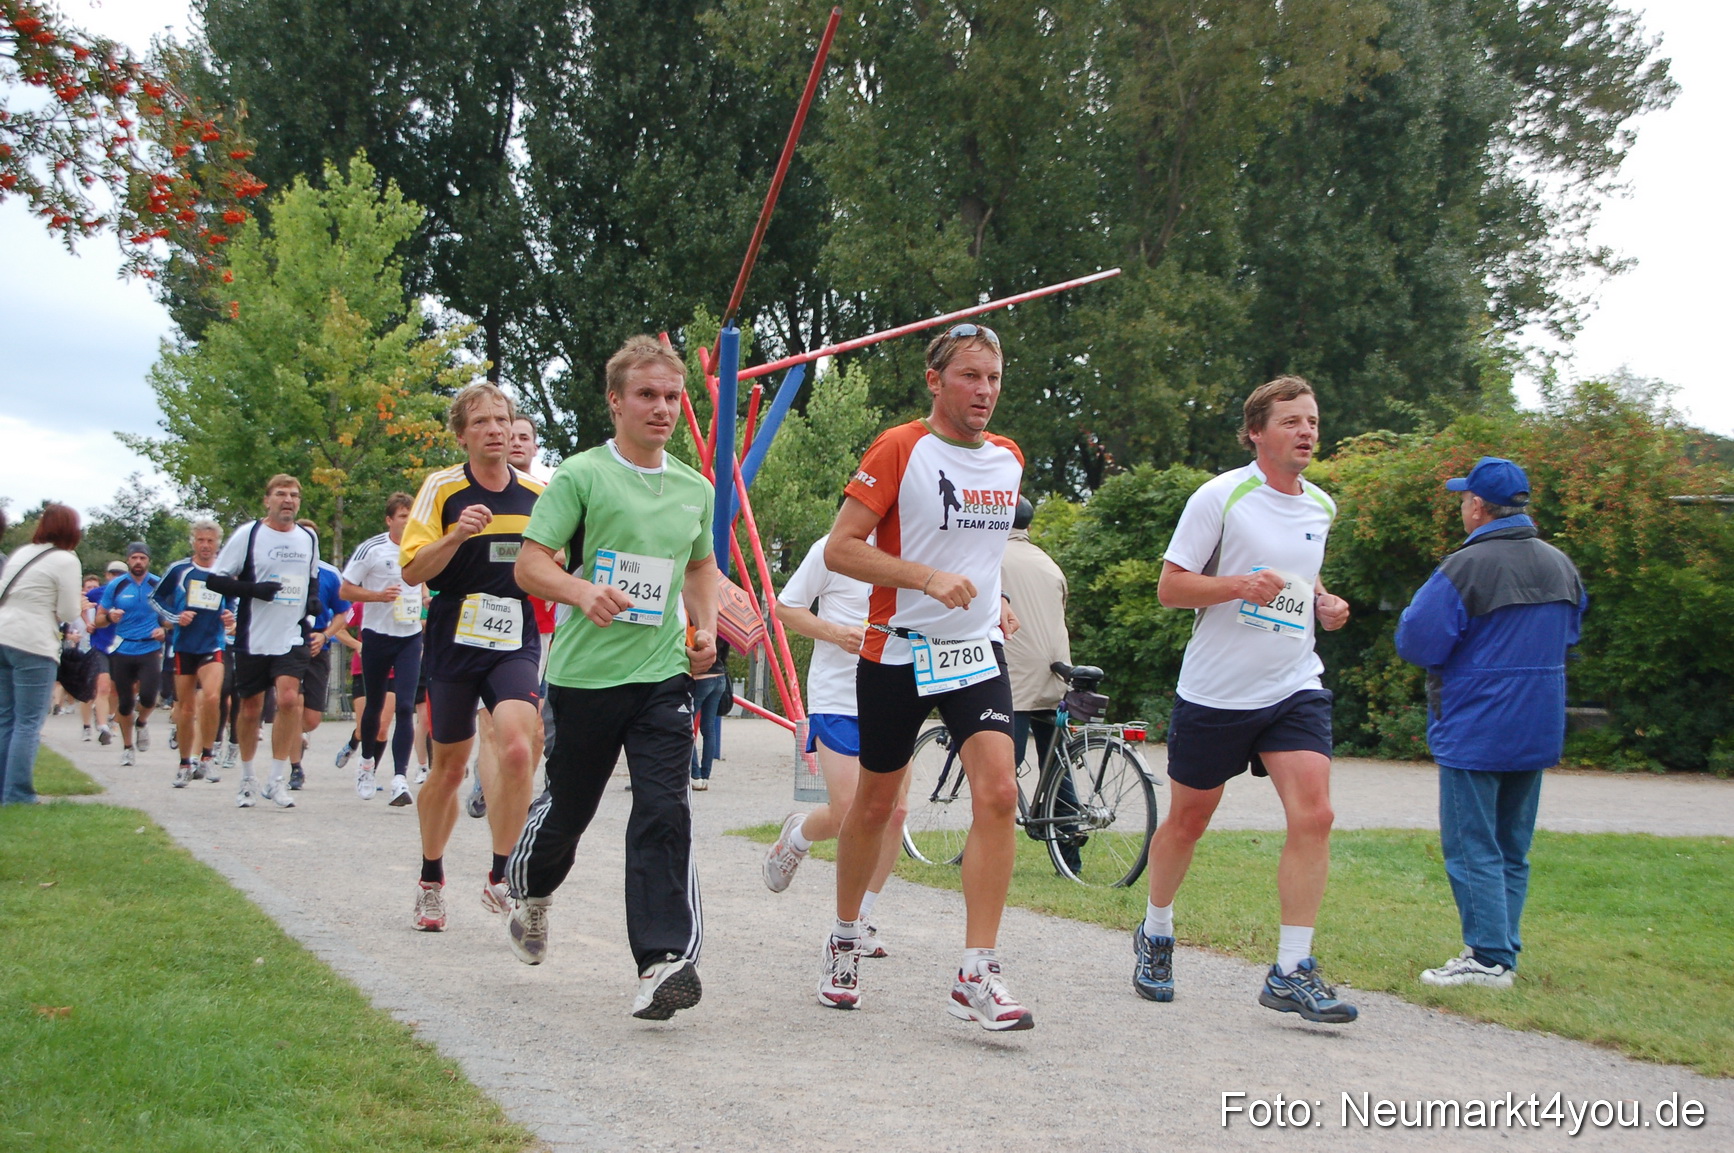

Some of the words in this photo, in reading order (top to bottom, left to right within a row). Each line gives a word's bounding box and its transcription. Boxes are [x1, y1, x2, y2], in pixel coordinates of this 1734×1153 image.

[961, 488, 1014, 507] MERZ
[962, 499, 1008, 516] Reisen
[956, 518, 986, 530] TEAM
[987, 520, 1010, 531] 2008
[275, 551, 307, 559] Fischer
[619, 559, 641, 574] Willi
[618, 579, 662, 602] 2434
[482, 598, 512, 614] Thomas
[463, 611, 469, 619] C
[483, 616, 513, 634] 442
[919, 654, 925, 663] A
[938, 645, 984, 669] 2780
